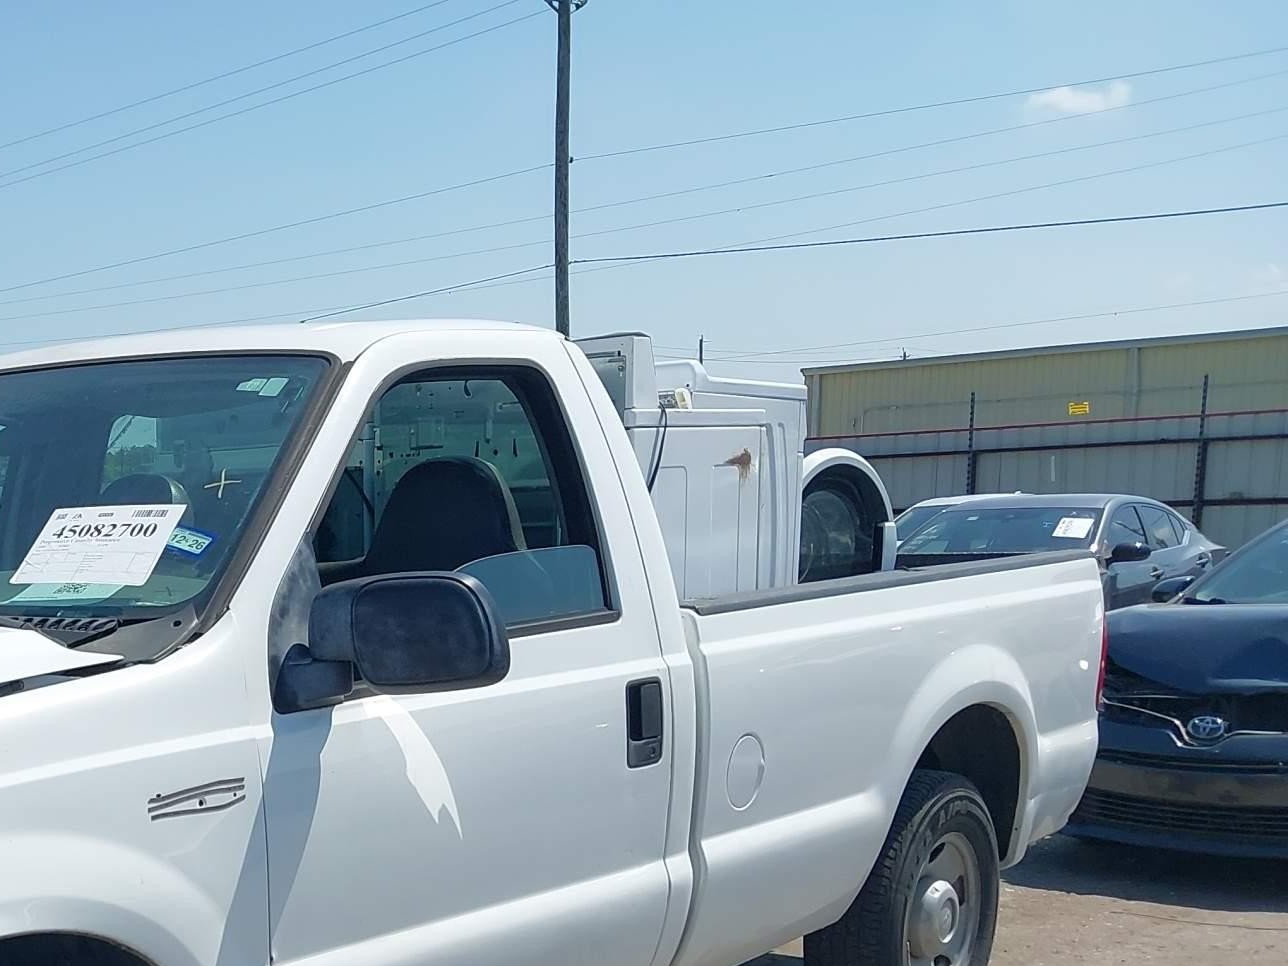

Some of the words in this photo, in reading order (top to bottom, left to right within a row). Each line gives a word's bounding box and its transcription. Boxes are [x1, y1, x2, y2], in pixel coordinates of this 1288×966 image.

[52, 522, 158, 539] 45082700
[170, 533, 186, 545] 12
[188, 539, 206, 550] 26
